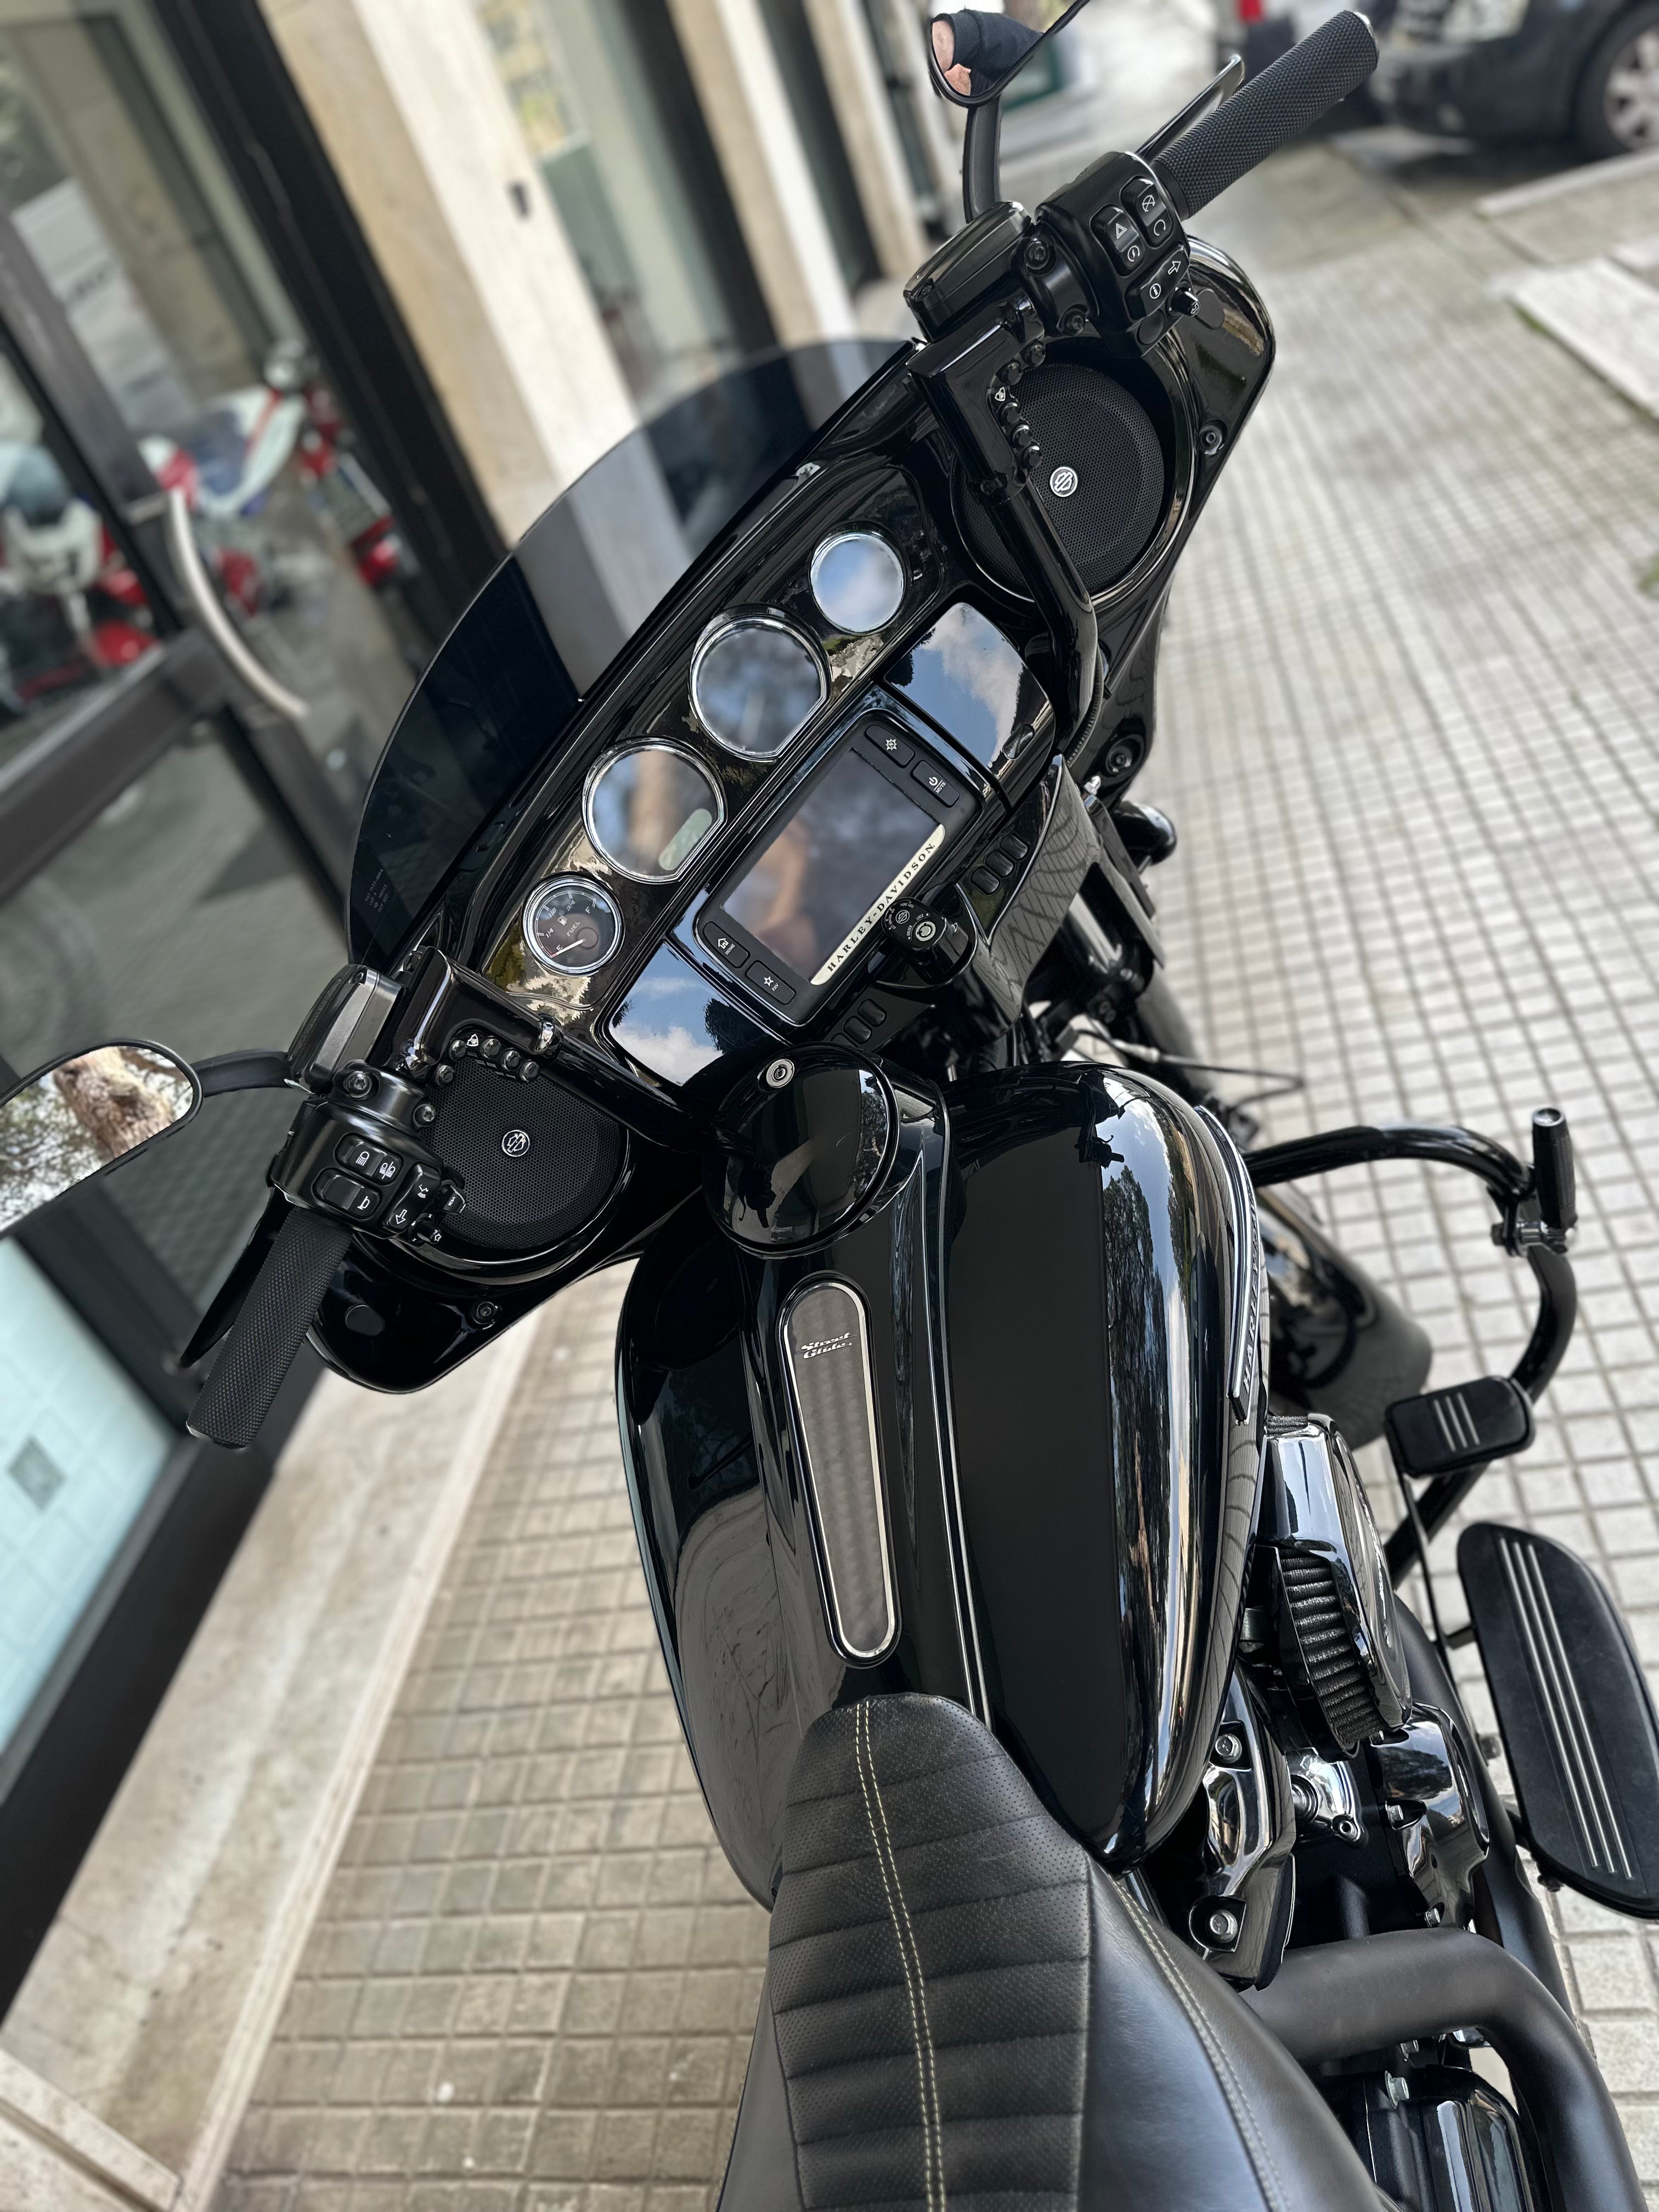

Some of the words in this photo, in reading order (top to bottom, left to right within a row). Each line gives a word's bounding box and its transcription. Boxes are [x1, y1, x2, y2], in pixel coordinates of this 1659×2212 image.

[935, 781, 946, 793] MUTE
[566, 900, 575, 912] 3/4
[827, 844, 934, 972] HARLEY-DAVIDSON
[549, 907, 557, 918] 1/2
[545, 928, 554, 938] 1/4
[566, 922, 580, 936] FUEL
[725, 943, 736, 955] HOME
